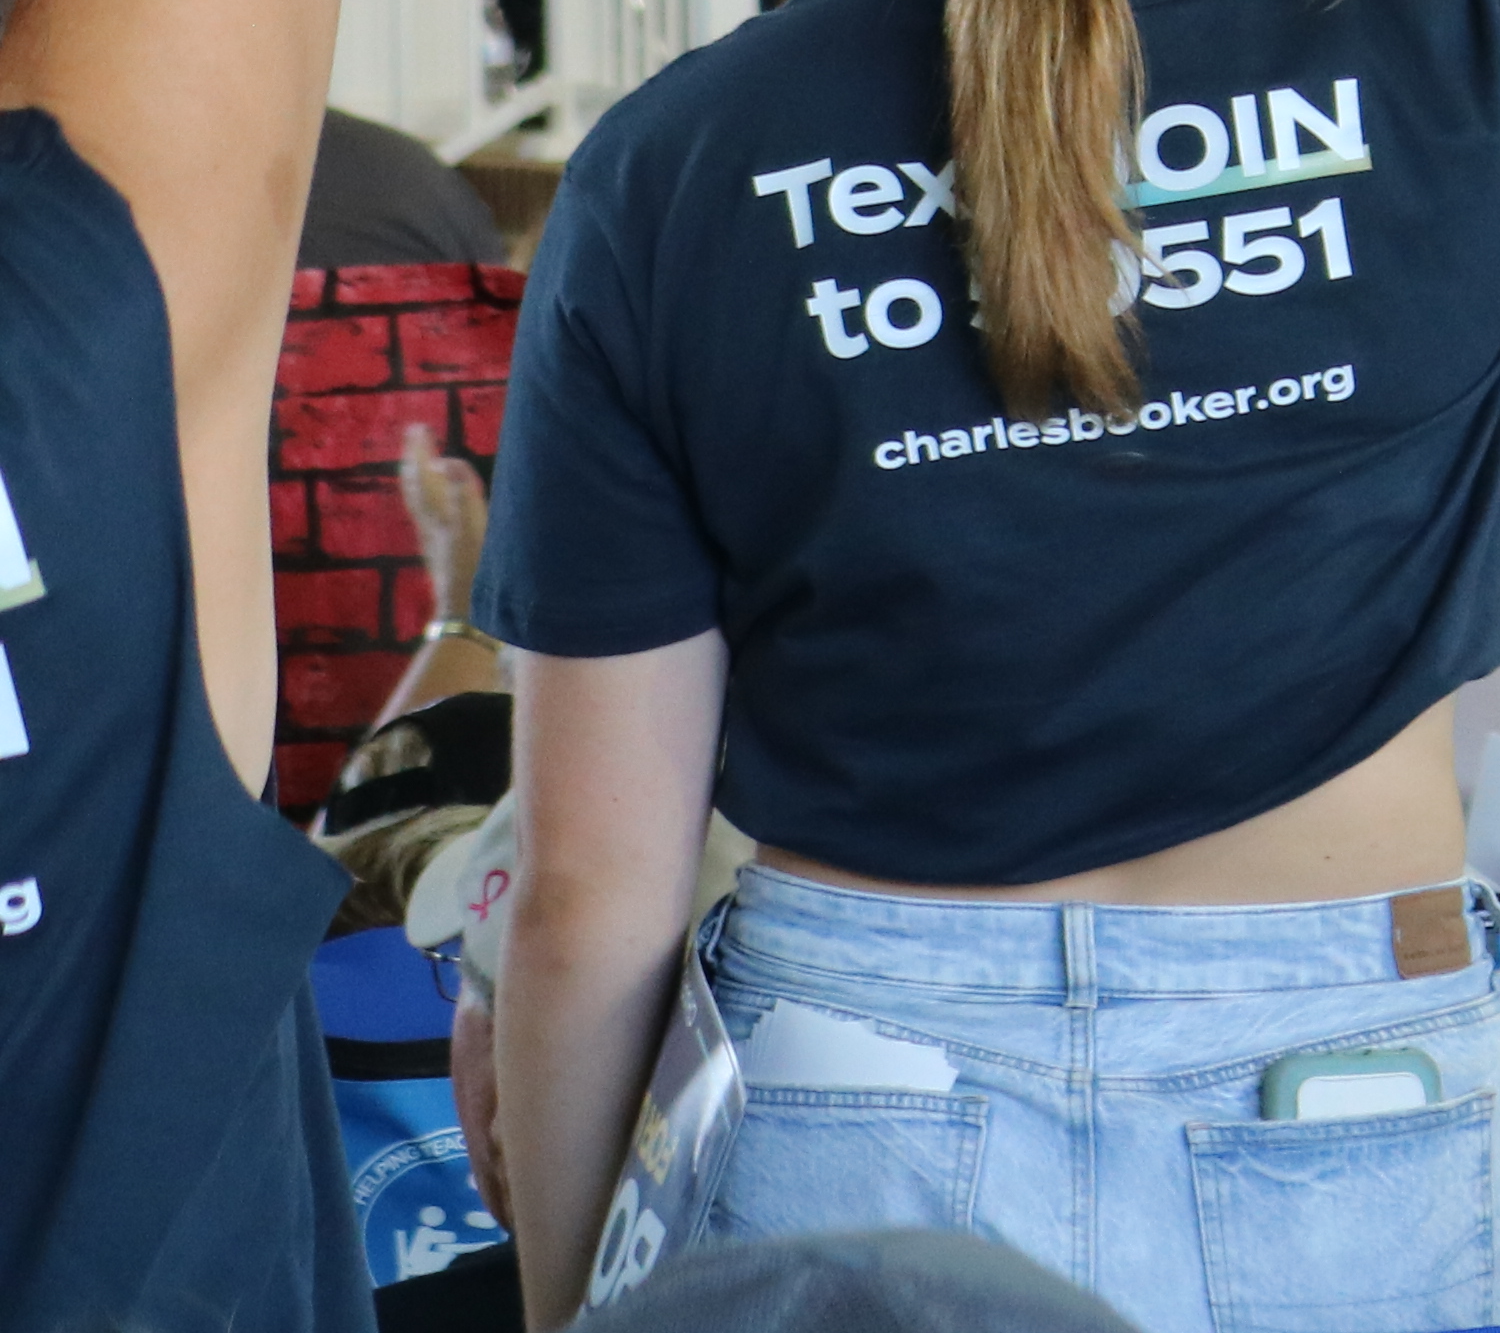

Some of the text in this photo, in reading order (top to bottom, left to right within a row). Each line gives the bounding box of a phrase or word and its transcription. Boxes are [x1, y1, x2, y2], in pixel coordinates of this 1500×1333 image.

[753, 78, 1367, 249] Tex OIN
[806, 278, 943, 360] to
[352, 1144, 421, 1207] HELPING
